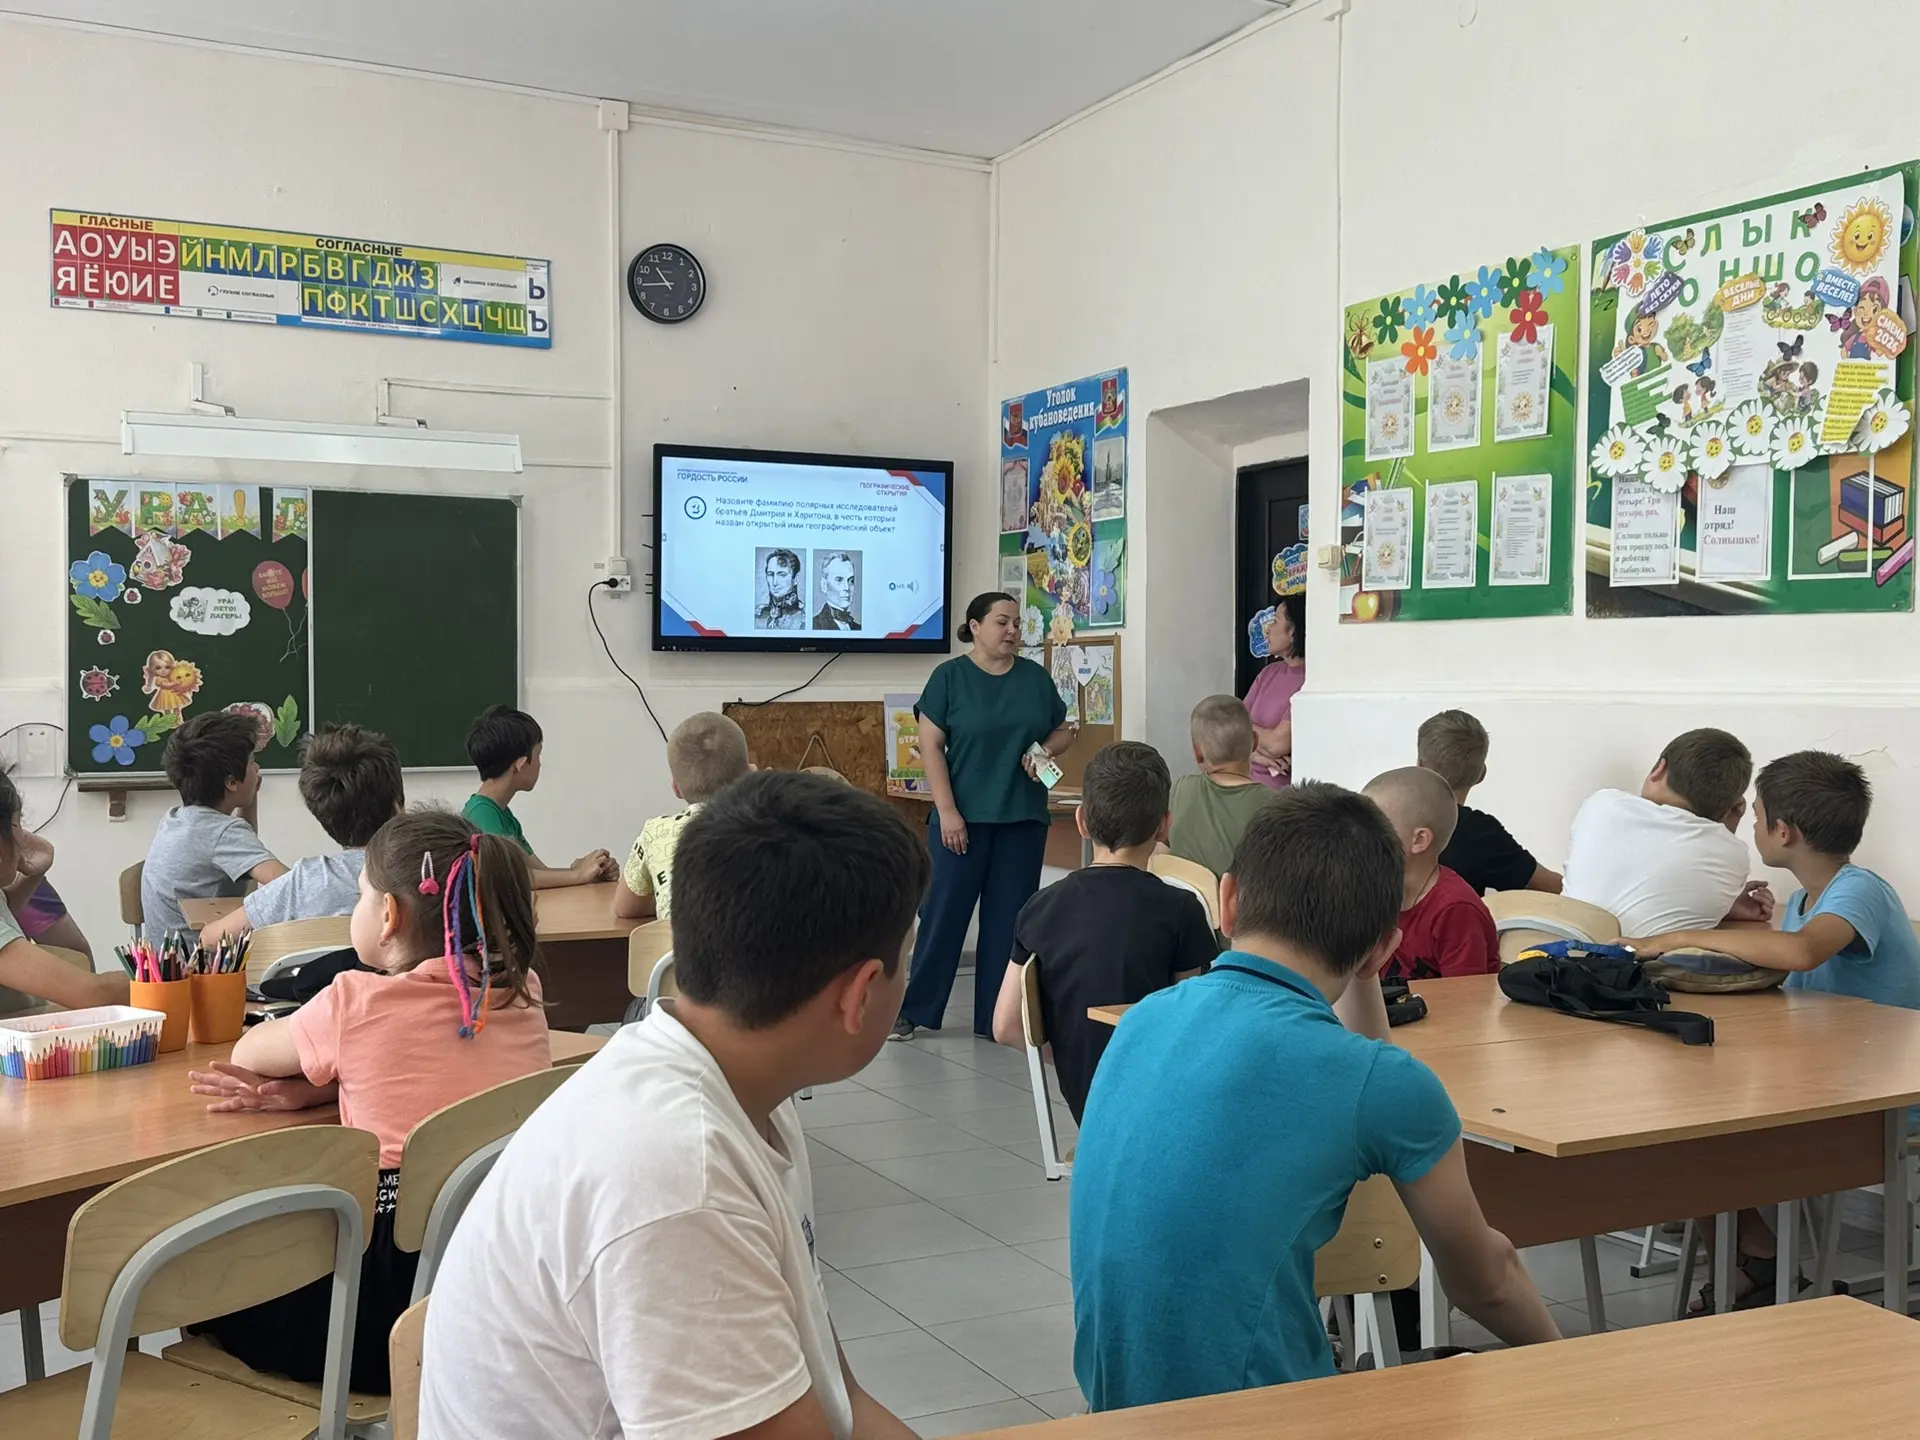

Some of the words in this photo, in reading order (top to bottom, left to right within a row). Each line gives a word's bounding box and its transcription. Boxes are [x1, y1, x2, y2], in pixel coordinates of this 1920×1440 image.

[79, 214, 154, 231] ГЛАСНЫЕ
[315, 238, 403, 257] СОГЛАСНЫЕ
[649, 254, 660, 263] 11
[662, 252, 673, 260] 12
[679, 258, 684, 266] 1
[640, 265, 650, 274] 10
[688, 269, 694, 278] 2
[637, 277, 642, 285] 9
[691, 283, 697, 291] 3
[1825, 274, 1857, 292] ВМЕСТЕ
[1650, 279, 1670, 302] ЛЕТО
[1722, 279, 1761, 298] ВЕСЕЛЫЕ
[1816, 283, 1855, 303] ВЕСЕЛЕЕ
[640, 291, 646, 299] 8
[687, 297, 693, 305] 4
[1644, 301, 1659, 314] БЕЗ
[1660, 279, 1682, 302] СКУКИ
[1732, 290, 1756, 308] ДНИ
[650, 302, 655, 310] 7
[663, 308, 669, 316] 6
[678, 305, 684, 313] 5
[1876, 315, 1906, 343] СМЕНА
[1046, 387, 1077, 409] Уголок
[1029, 401, 1095, 434] кубановедения
[677, 472, 716, 482] ГОРДОСТЬ
[717, 474, 748, 483] РОССИИ
[859, 482, 910, 491] ГЕОГРАФИЧЕСКИЕ
[715, 497, 754, 505] Назовите
[755, 498, 794, 508] фамилию
[796, 501, 835, 510] полярных
[836, 503, 898, 512] исследователей
[1714, 505, 1736, 515] Наш
[715, 507, 748, 516] братьев
[749, 508, 785, 518] Дмитрия
[794, 510, 832, 520] Харитона,
[864, 515, 896, 523] которых
[746, 520, 786, 529] открытый
[805, 522, 868, 532] географический
[869, 525, 896, 533] объект
[1704, 519, 1735, 532] отряд!
[1703, 533, 1760, 545] Солнышко!
